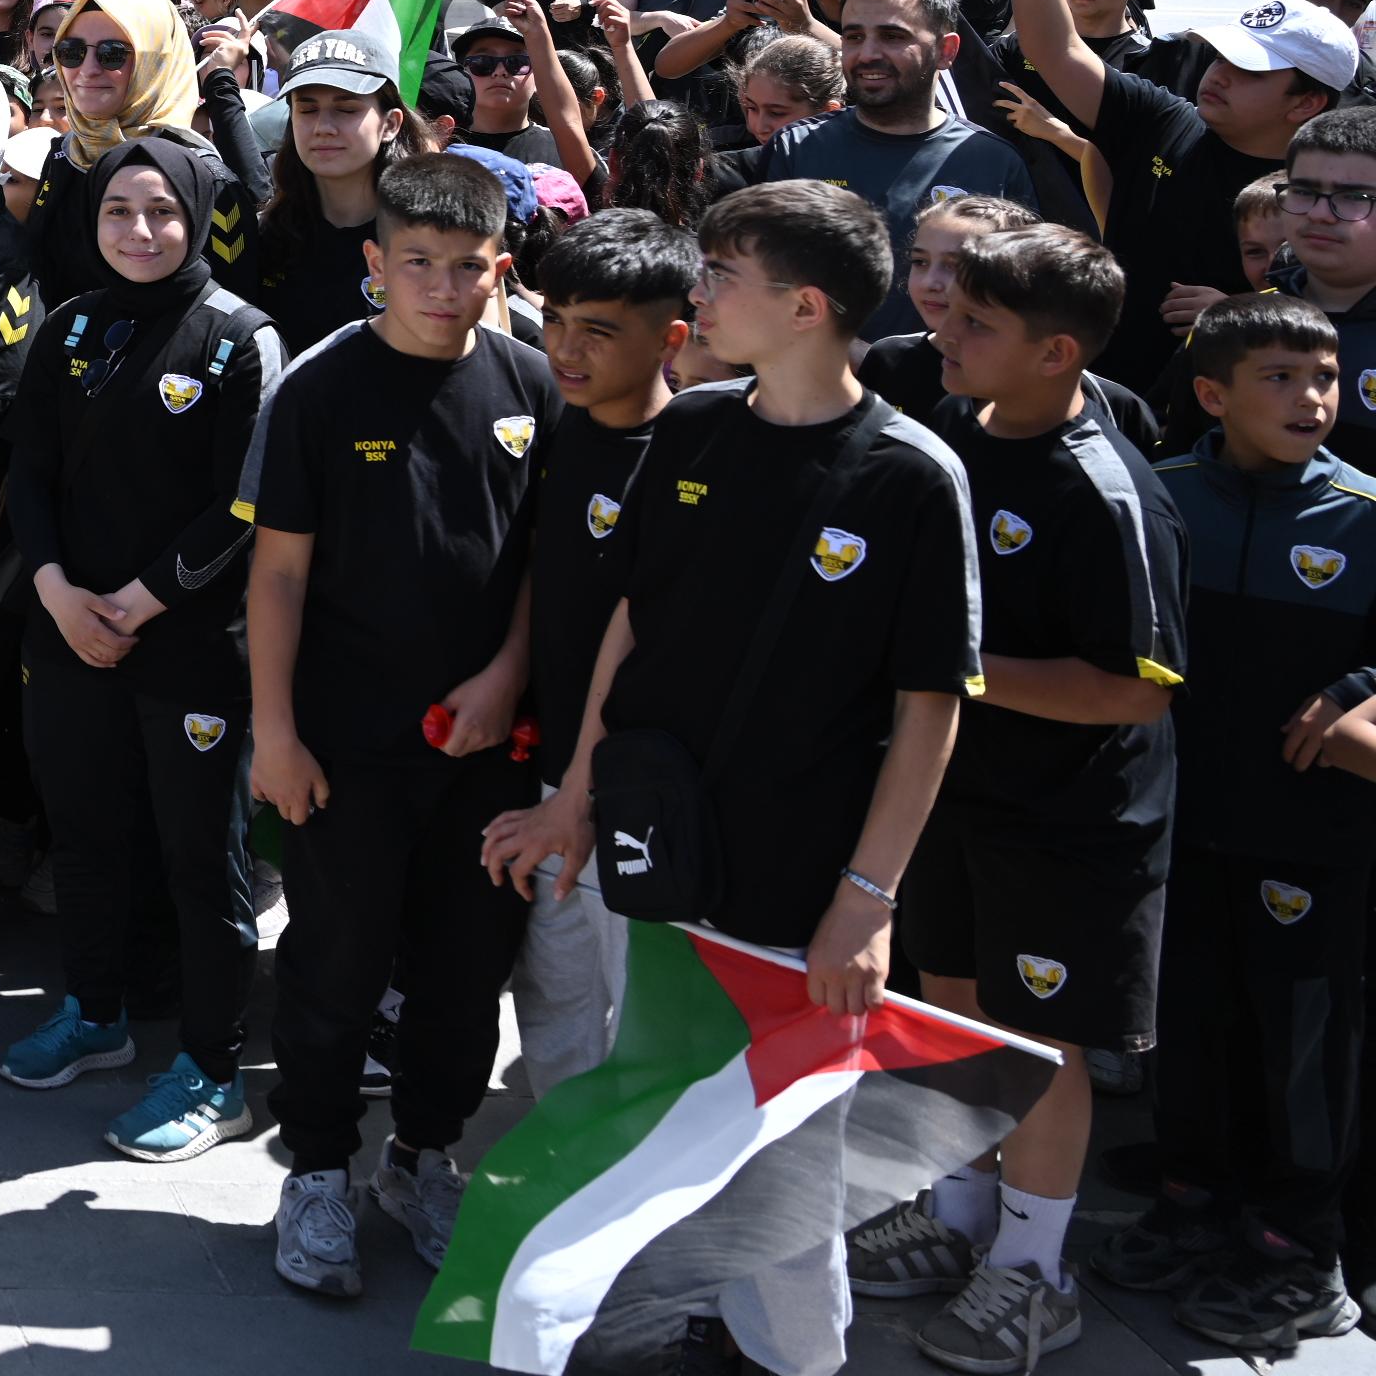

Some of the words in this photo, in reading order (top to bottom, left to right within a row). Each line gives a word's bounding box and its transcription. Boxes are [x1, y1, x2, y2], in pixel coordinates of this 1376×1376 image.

[324, 38, 367, 66] YORK
[71, 358, 89, 370] NYA
[354, 440, 397, 452] KONYA
[616, 858, 648, 876] PUMA
